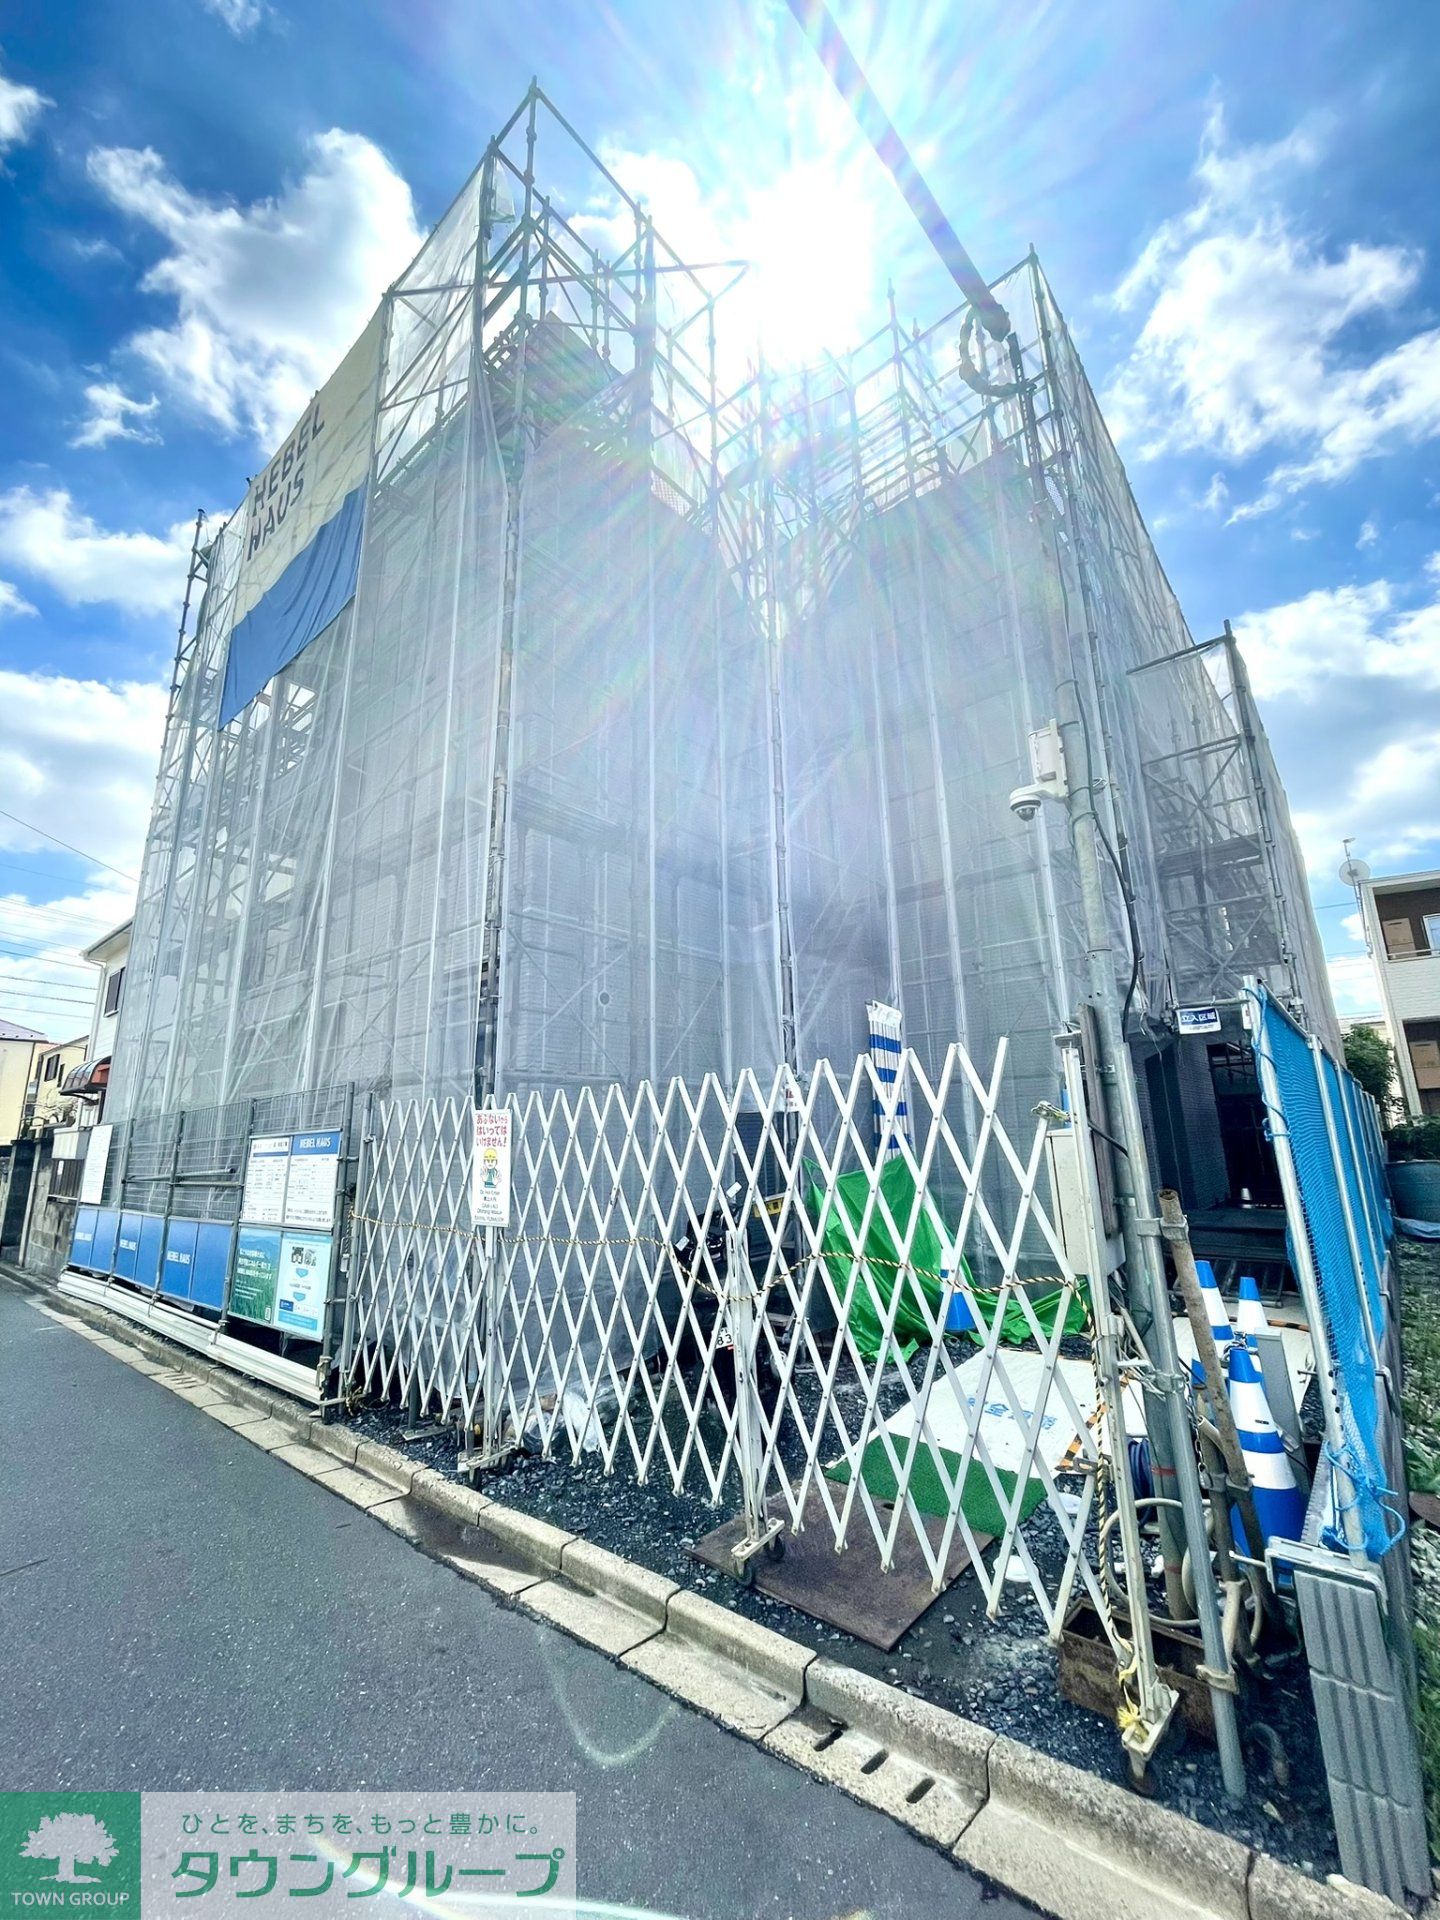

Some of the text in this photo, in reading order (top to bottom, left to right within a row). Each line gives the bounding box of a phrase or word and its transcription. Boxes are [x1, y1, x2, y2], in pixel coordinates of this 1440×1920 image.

[246, 460, 307, 562] HAUS
[252, 402, 326, 518] HEBEL
[476, 1125, 508, 1136] はいっては
